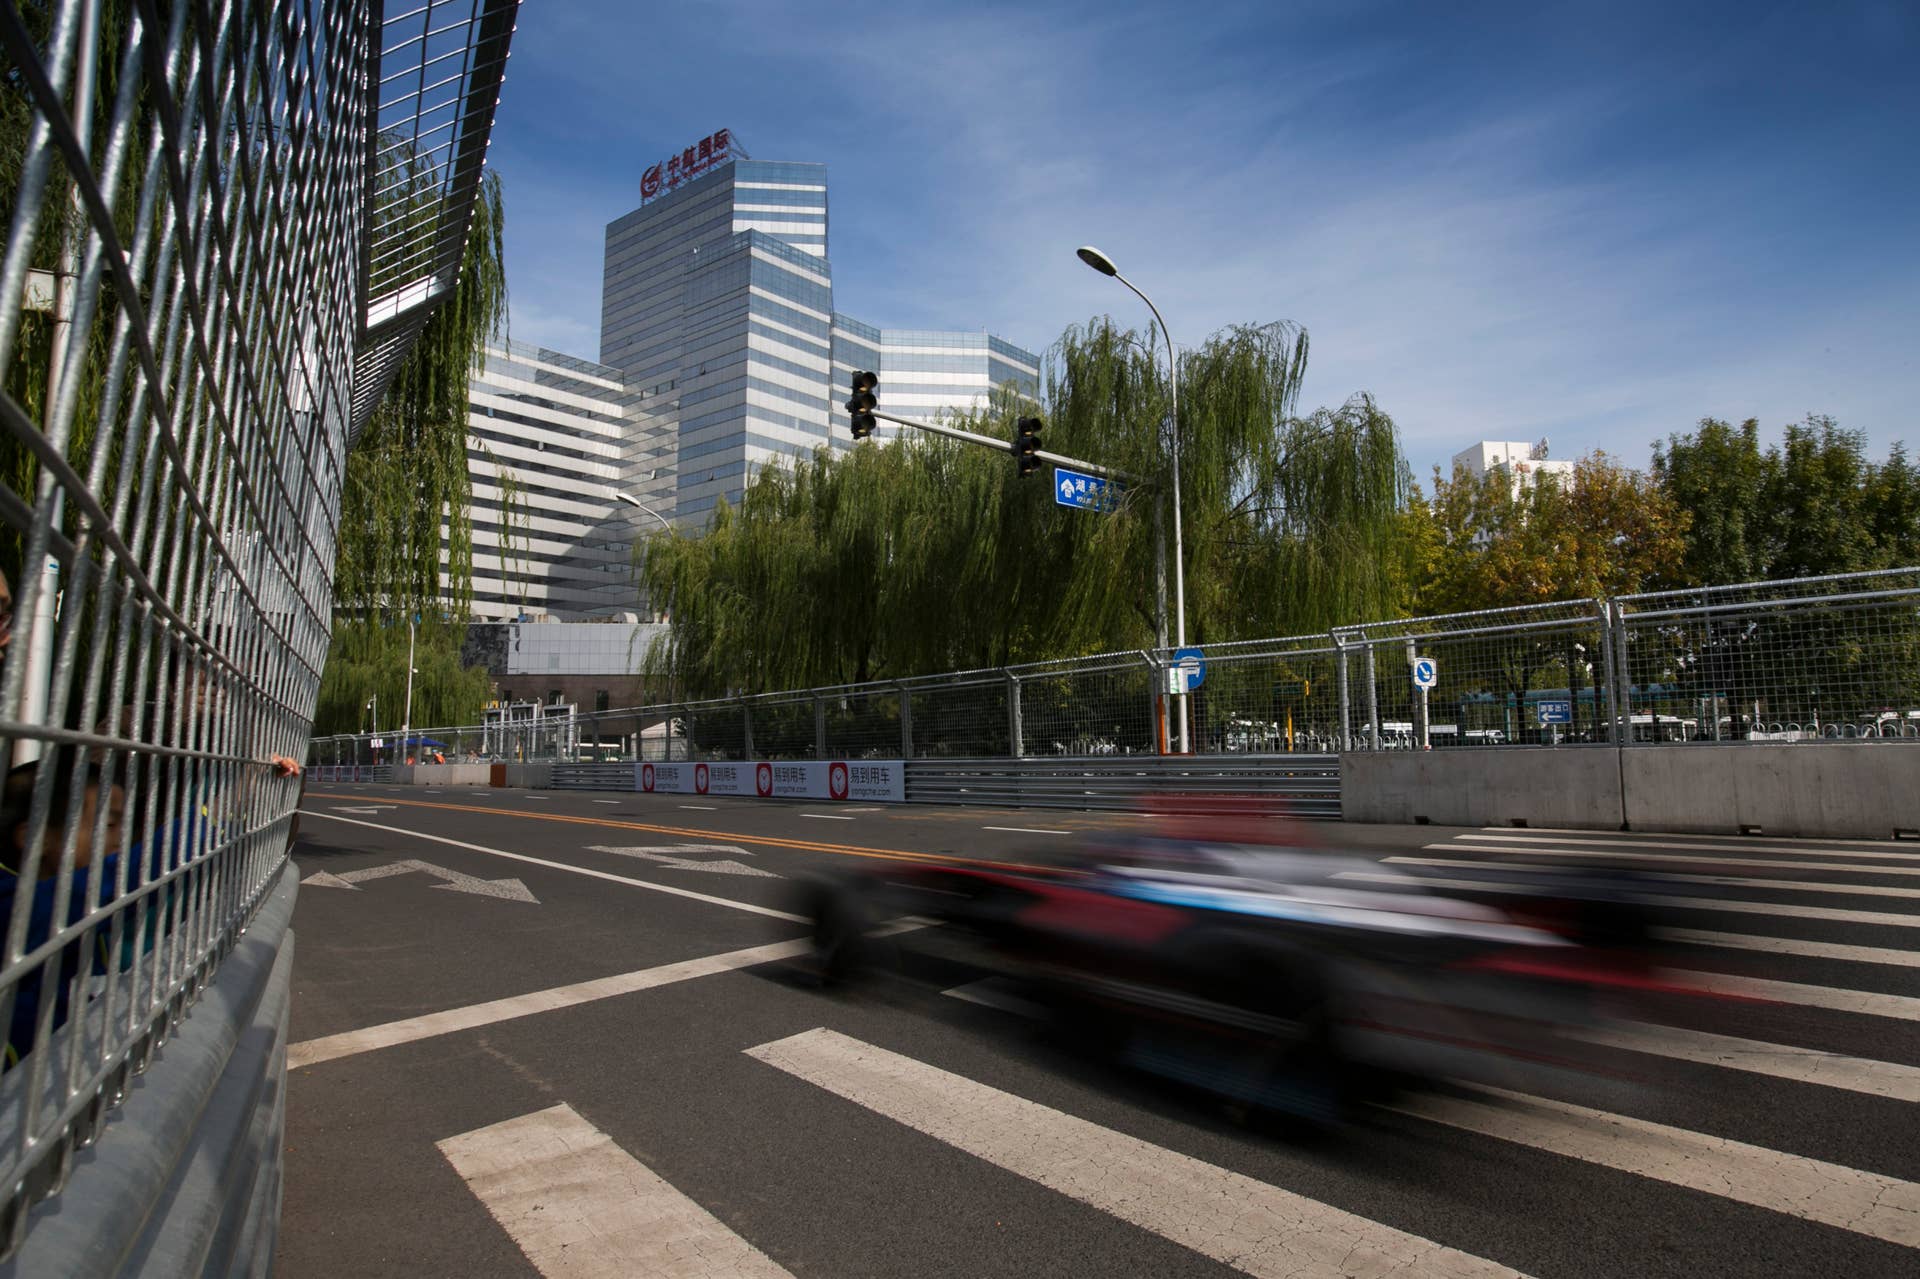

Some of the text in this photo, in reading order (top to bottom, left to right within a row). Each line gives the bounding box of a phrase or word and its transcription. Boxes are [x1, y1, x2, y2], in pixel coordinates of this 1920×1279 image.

[774, 767, 807, 783] 易到用车
[850, 766, 891, 784] 易到用车
